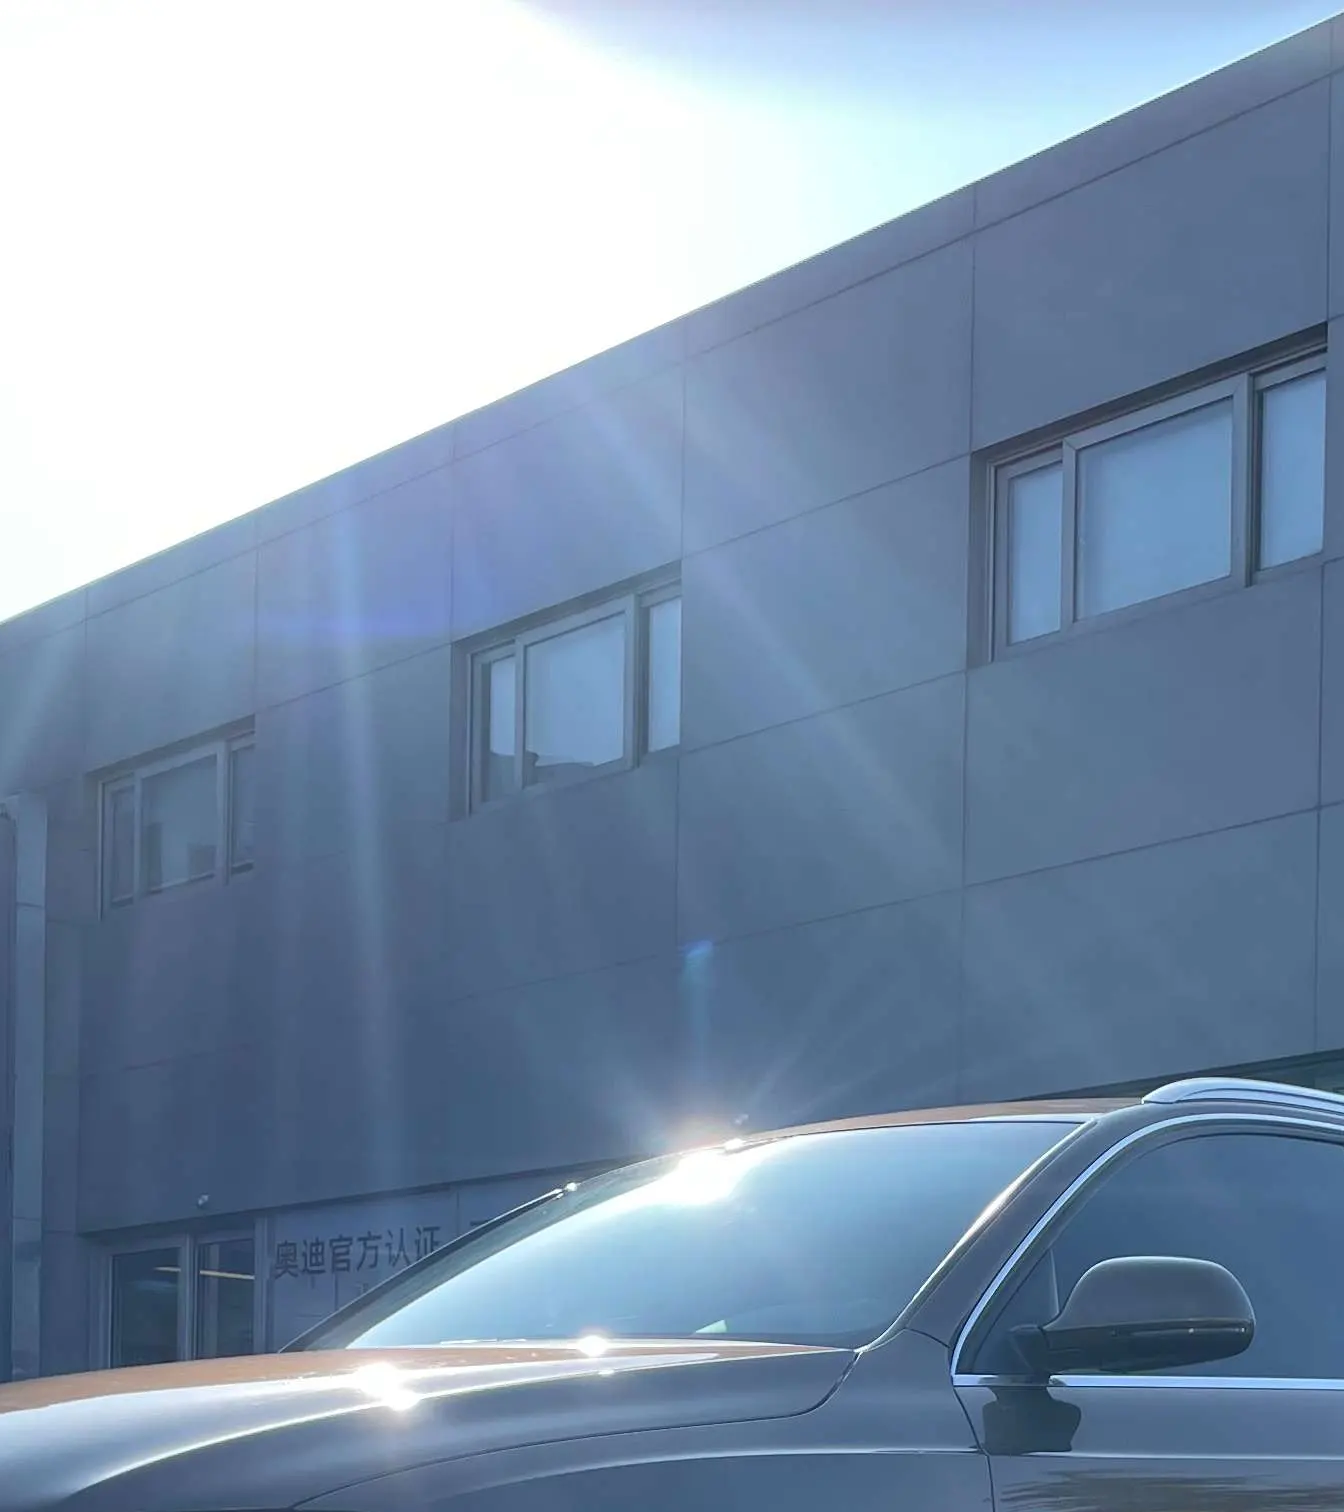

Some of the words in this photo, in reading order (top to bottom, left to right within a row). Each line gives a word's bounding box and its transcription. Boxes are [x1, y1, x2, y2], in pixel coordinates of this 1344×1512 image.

[274, 1219, 488, 1280] 奥迪官方认证
